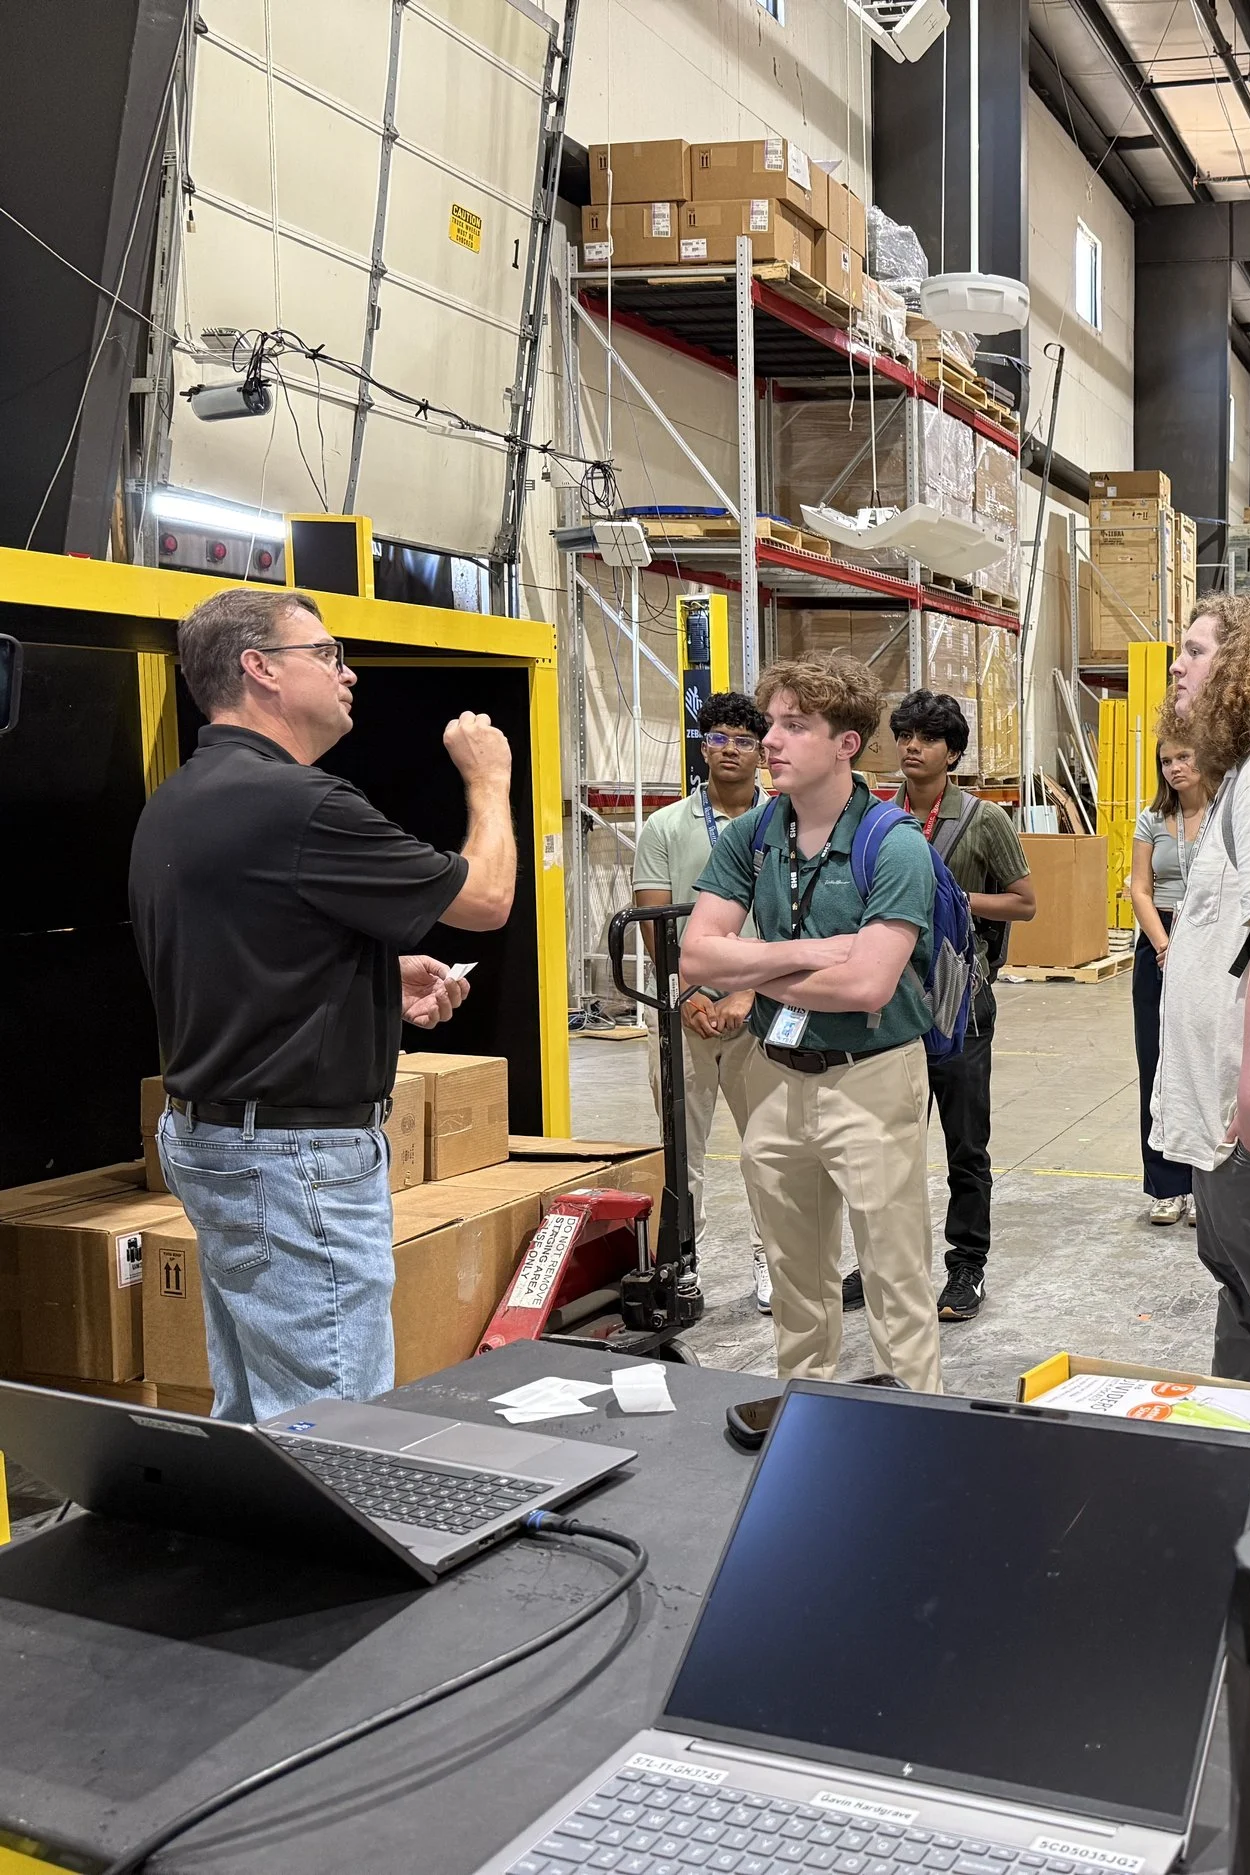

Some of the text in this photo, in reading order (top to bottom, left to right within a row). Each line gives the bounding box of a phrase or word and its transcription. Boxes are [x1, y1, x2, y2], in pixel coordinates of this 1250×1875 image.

[452, 204, 481, 229] CAUTION
[512, 239, 520, 269] 1
[686, 729, 704, 739] ZEB
[520, 1227, 549, 1279] USE ONLY
[524, 1216, 564, 1295] STAGING AREA
[532, 1217, 576, 1305] DO NOT REMOVE
[820, 1793, 852, 1807] Gavin
